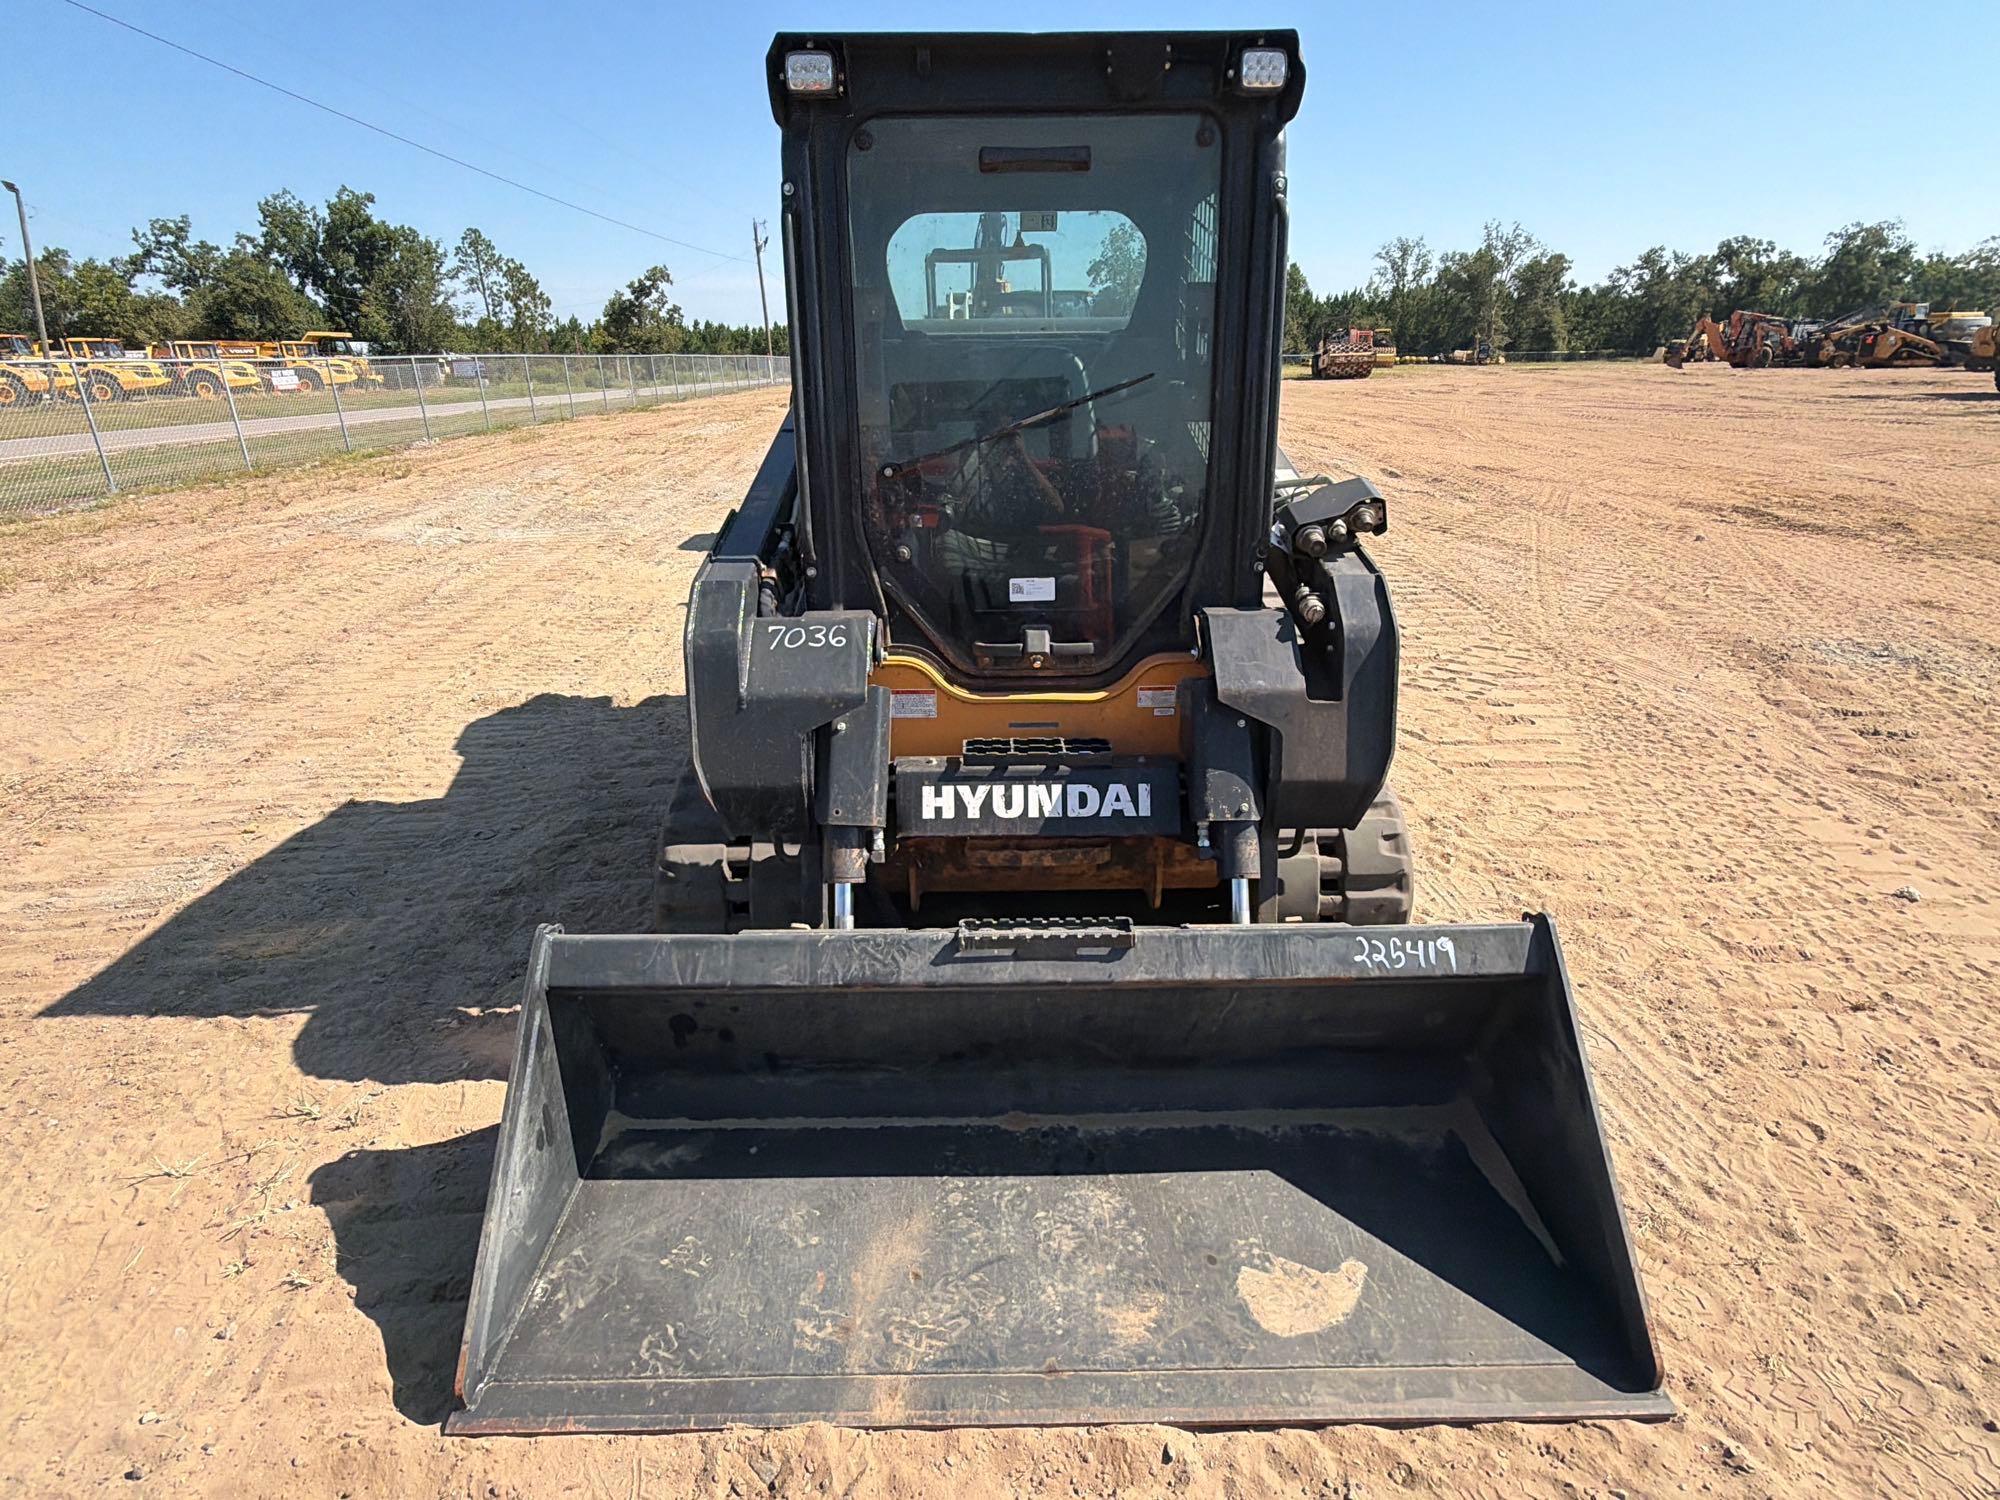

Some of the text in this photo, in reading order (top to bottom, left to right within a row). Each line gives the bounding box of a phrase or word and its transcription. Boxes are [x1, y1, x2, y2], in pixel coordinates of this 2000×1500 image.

[768, 625, 847, 650] 7036
[921, 783, 1151, 819] HYUNDAI
[1353, 936, 1457, 974] 225419
